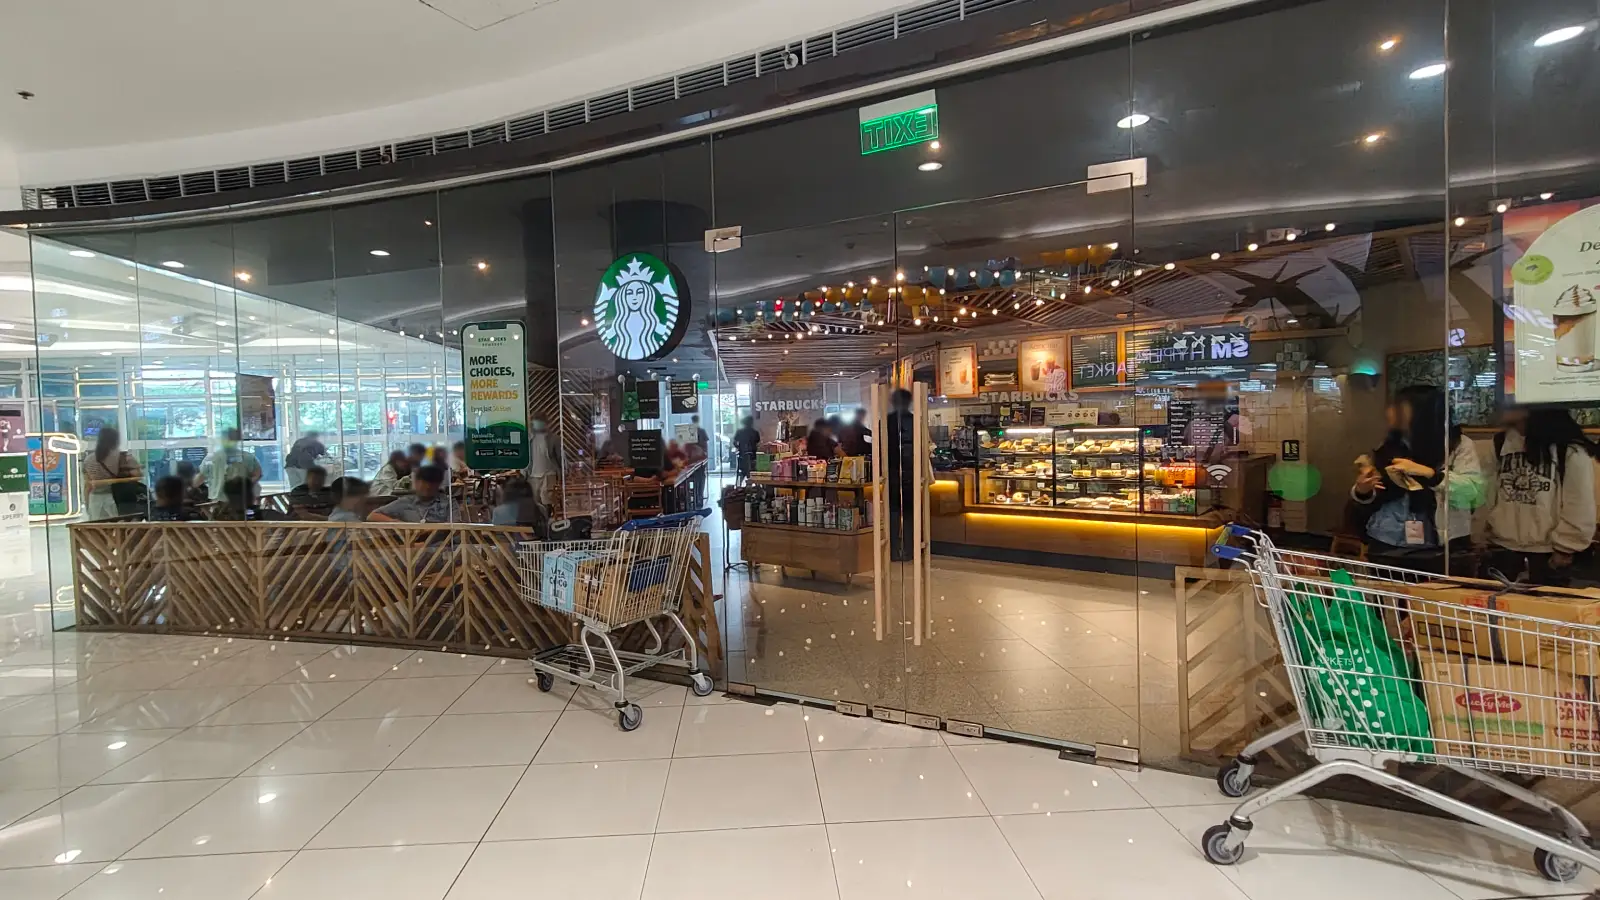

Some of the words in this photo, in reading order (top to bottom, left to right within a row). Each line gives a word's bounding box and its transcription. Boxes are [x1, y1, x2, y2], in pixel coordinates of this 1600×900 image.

[469, 355, 498, 365] MORE
[470, 366, 515, 377] CHOICES,
[470, 378, 498, 389] MORE
[471, 389, 519, 400] REWARDS
[979, 389, 1079, 403] STARBUCKS
[755, 399, 826, 412] STARBUCKS
[550, 567, 566, 580] VTA
[549, 576, 568, 588] CCO
